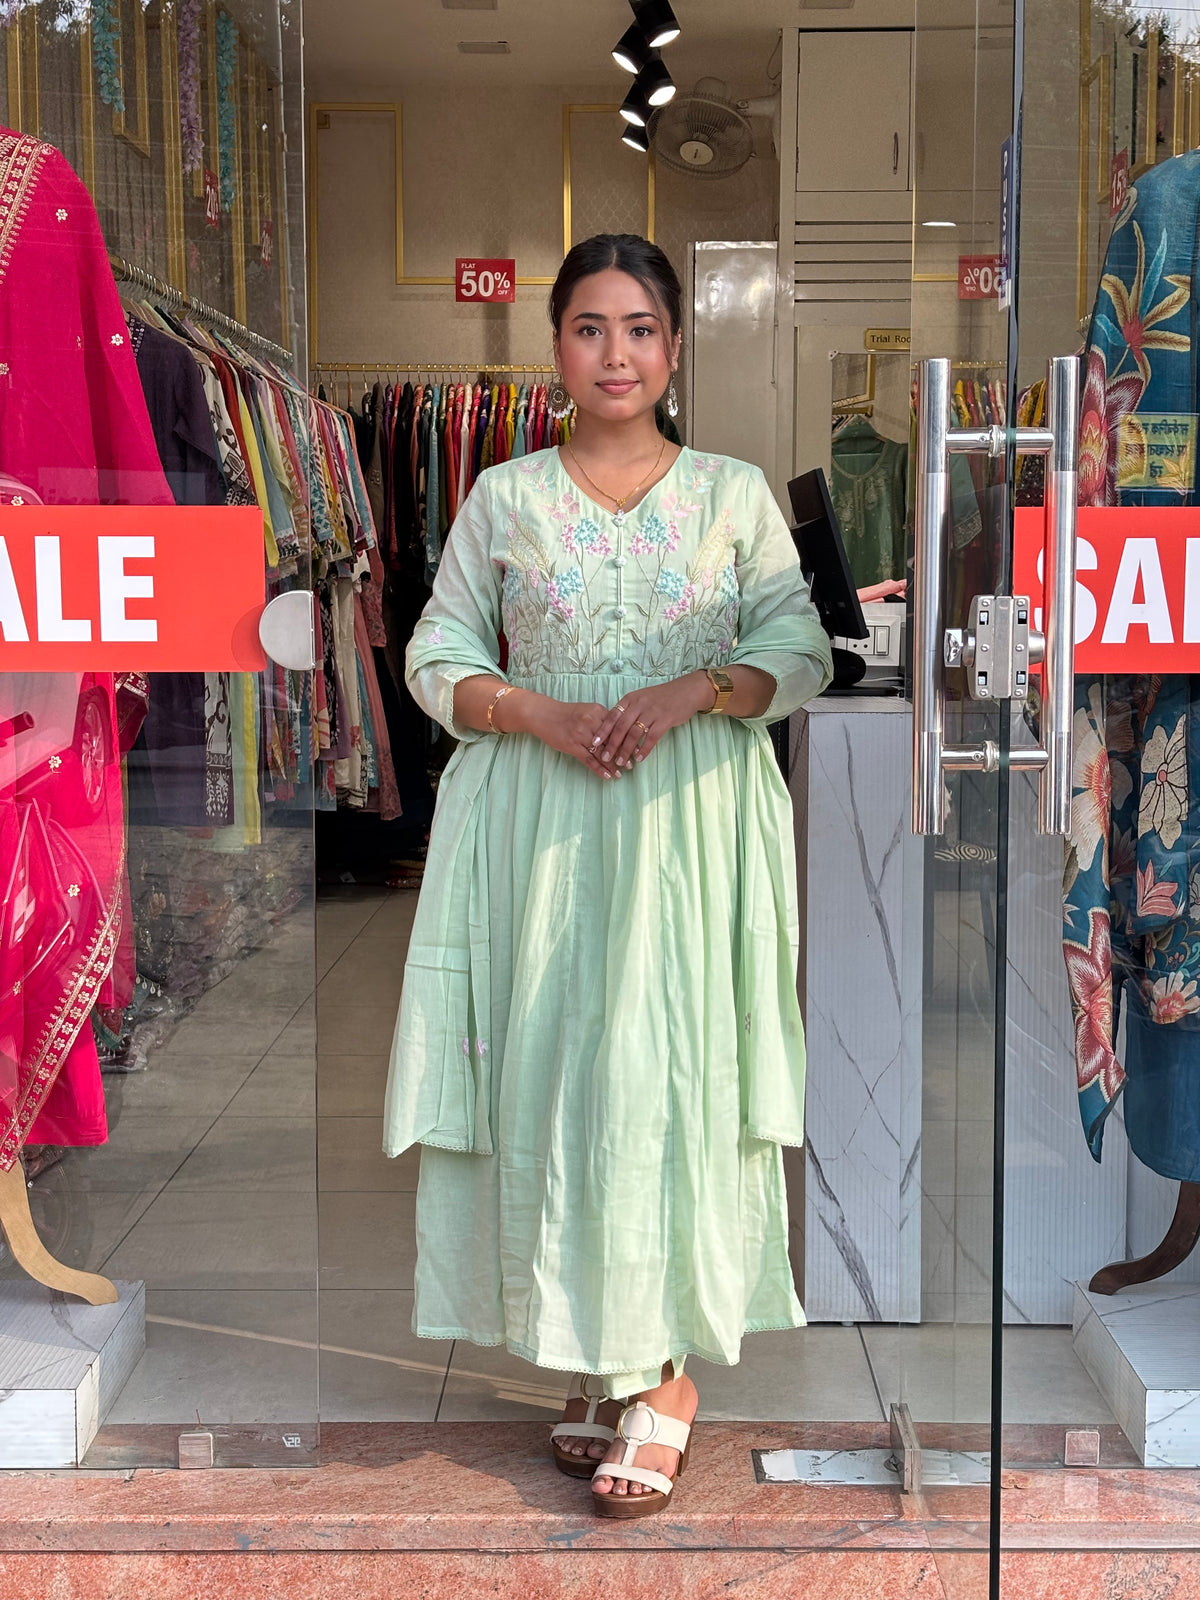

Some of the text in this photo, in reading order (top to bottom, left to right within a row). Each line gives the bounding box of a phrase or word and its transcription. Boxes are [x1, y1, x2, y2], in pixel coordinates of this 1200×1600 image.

[460, 270, 511, 297] 50%
[870, 334, 911, 344] Trial Roo
